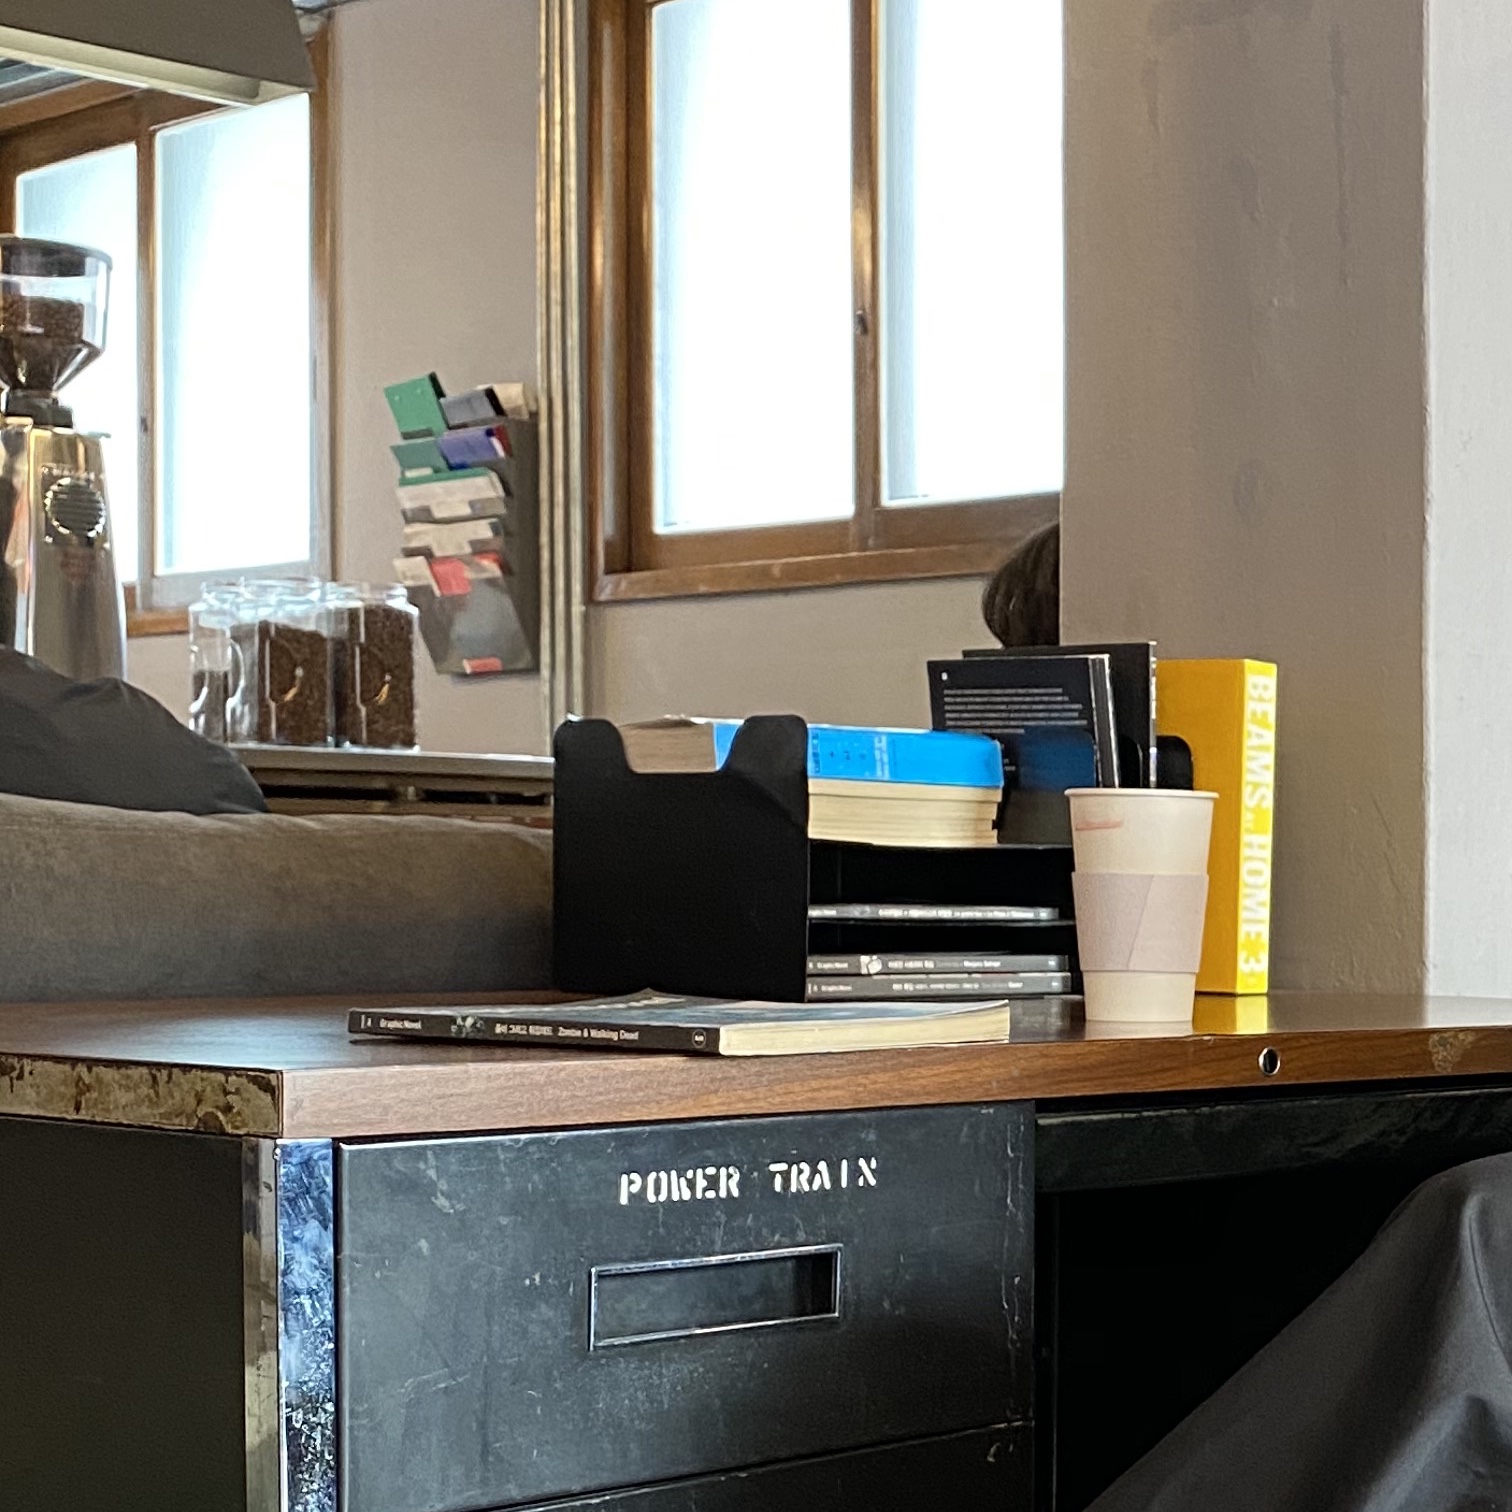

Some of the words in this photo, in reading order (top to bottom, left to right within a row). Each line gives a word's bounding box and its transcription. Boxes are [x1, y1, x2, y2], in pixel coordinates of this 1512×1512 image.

[1244, 674, 1274, 808] BEAMS
[1239, 834, 1270, 942] HOME
[1238, 951, 1267, 974] 3
[619, 1165, 740, 1205] POWER
[768, 1157, 877, 1193] TRAIN
